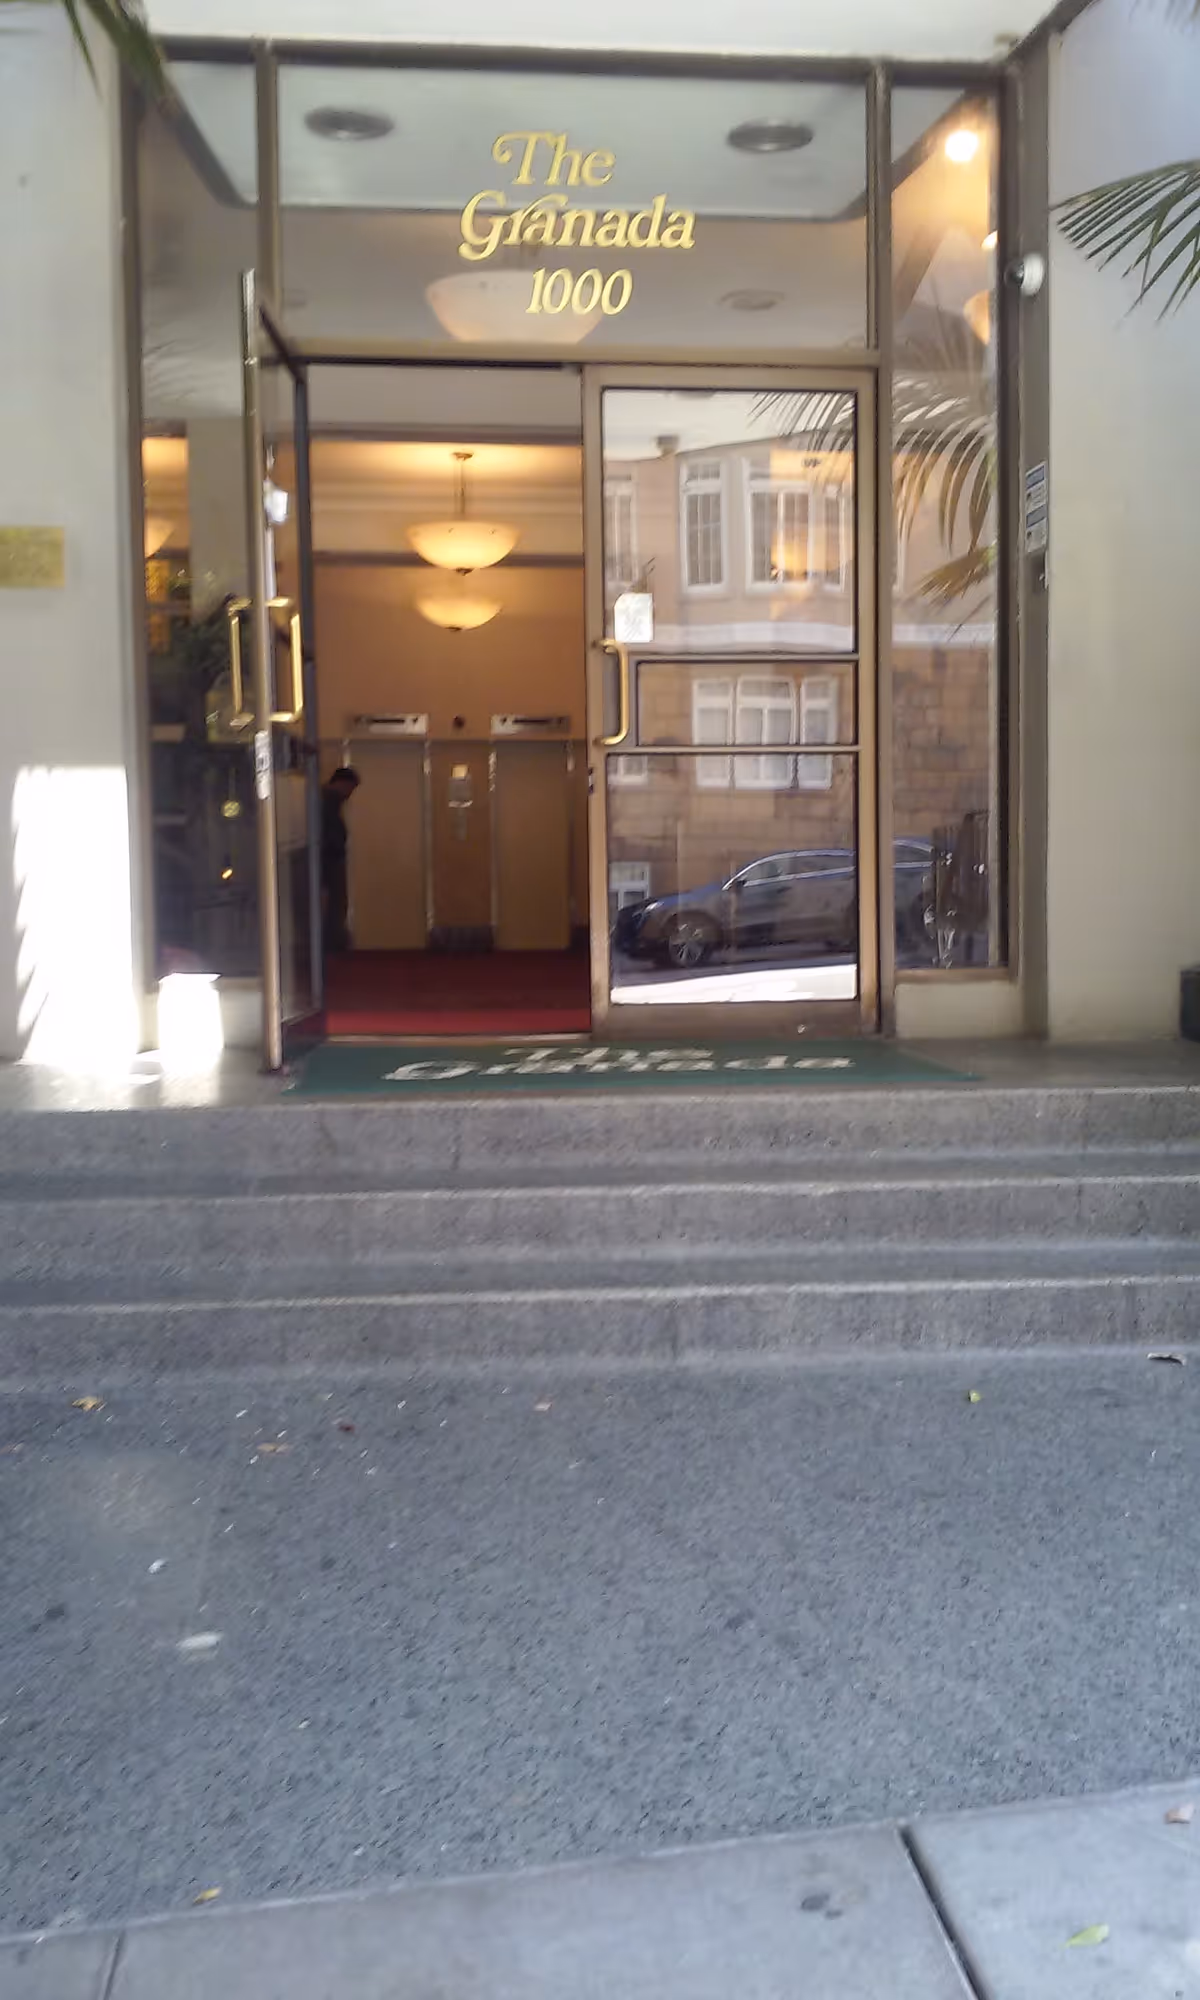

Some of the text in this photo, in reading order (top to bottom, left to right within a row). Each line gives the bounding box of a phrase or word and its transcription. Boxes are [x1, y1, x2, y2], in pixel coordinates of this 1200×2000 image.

[492, 130, 616, 186] The
[458, 189, 695, 261] Granada
[525, 267, 633, 315] 1000
